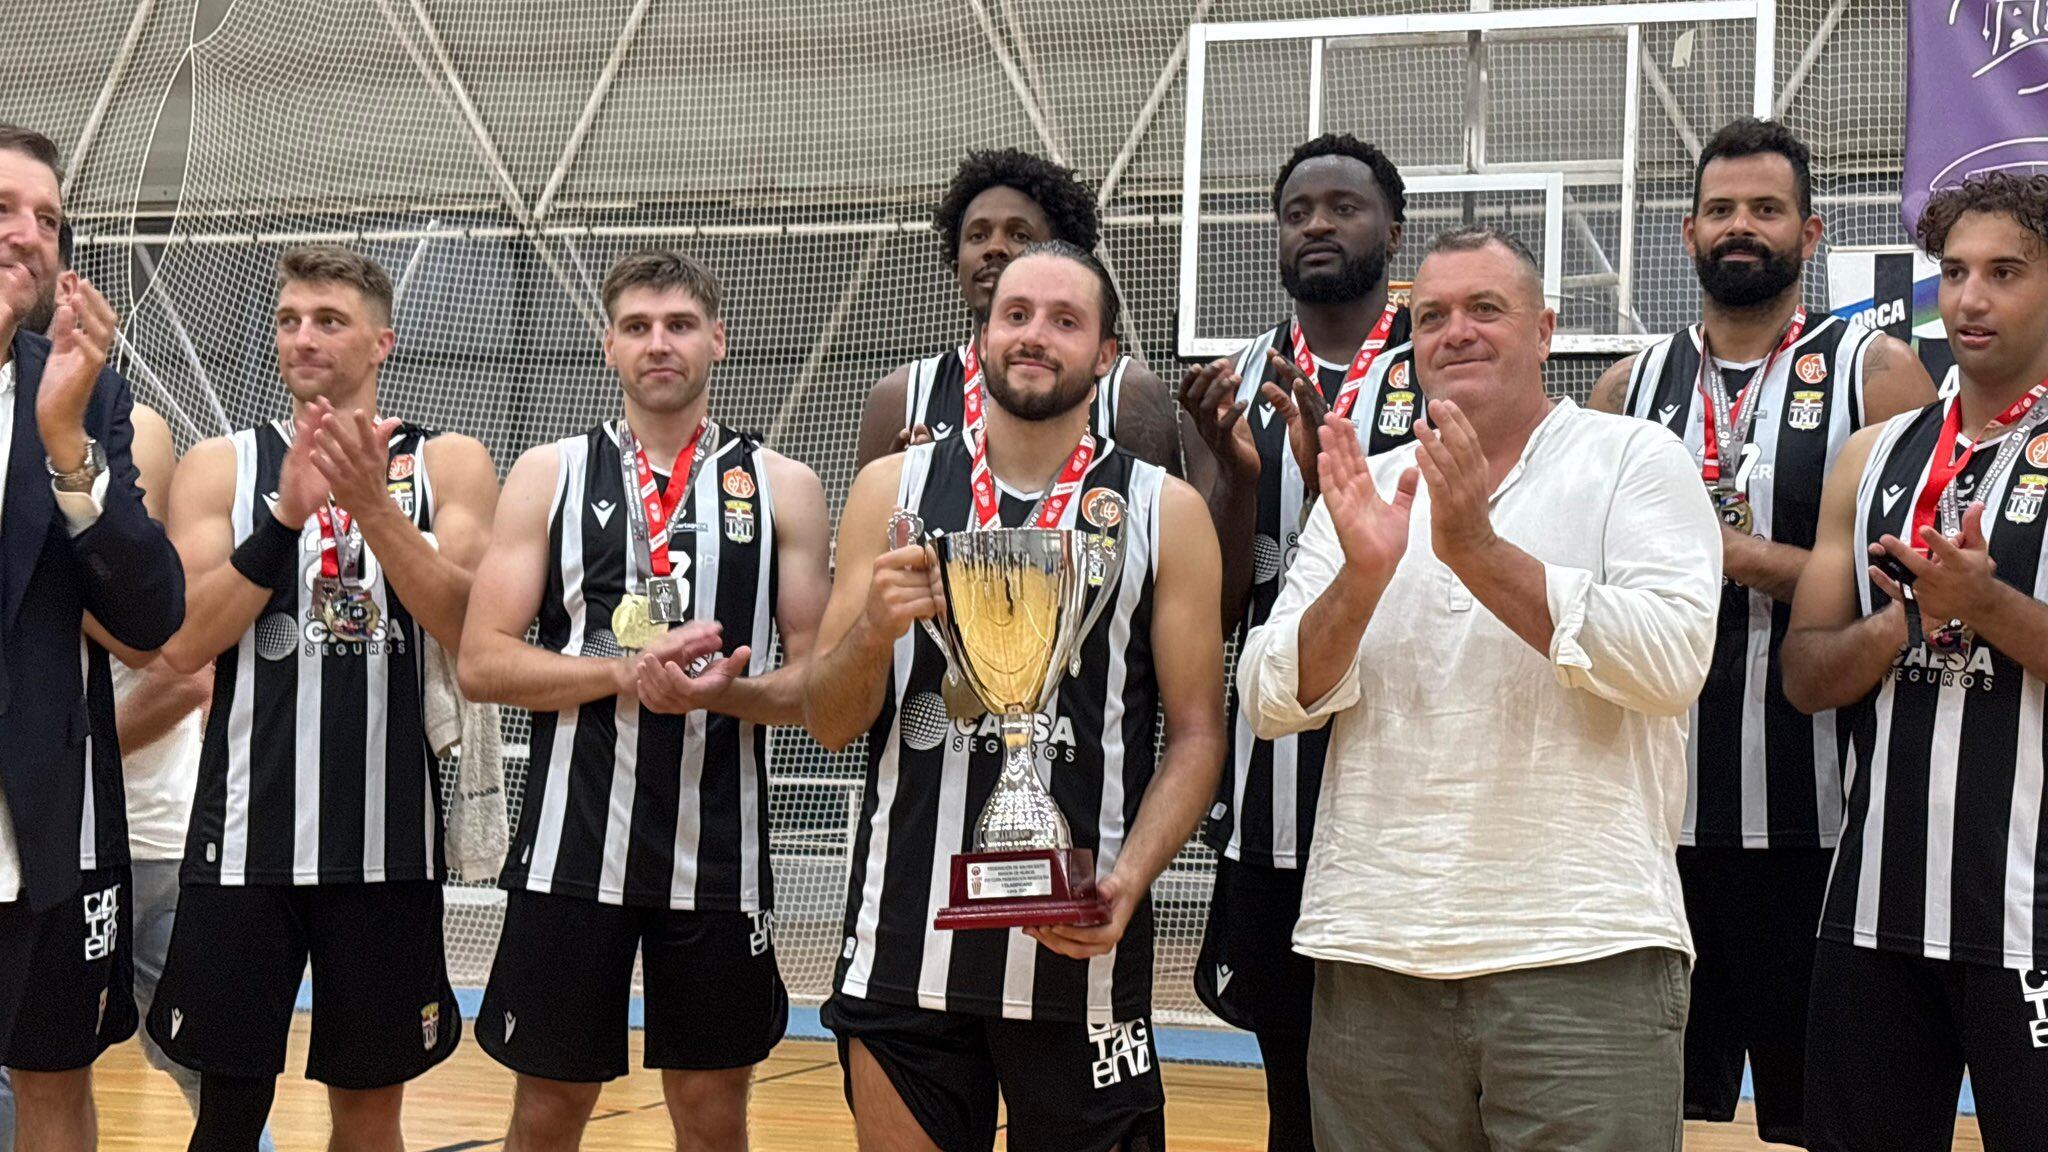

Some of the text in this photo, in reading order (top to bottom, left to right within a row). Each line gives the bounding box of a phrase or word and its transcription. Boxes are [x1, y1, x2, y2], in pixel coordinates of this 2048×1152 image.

[1849, 298, 1906, 330] ORCA
[304, 643, 406, 657] SEGUROS
[955, 713, 1077, 747] CASA
